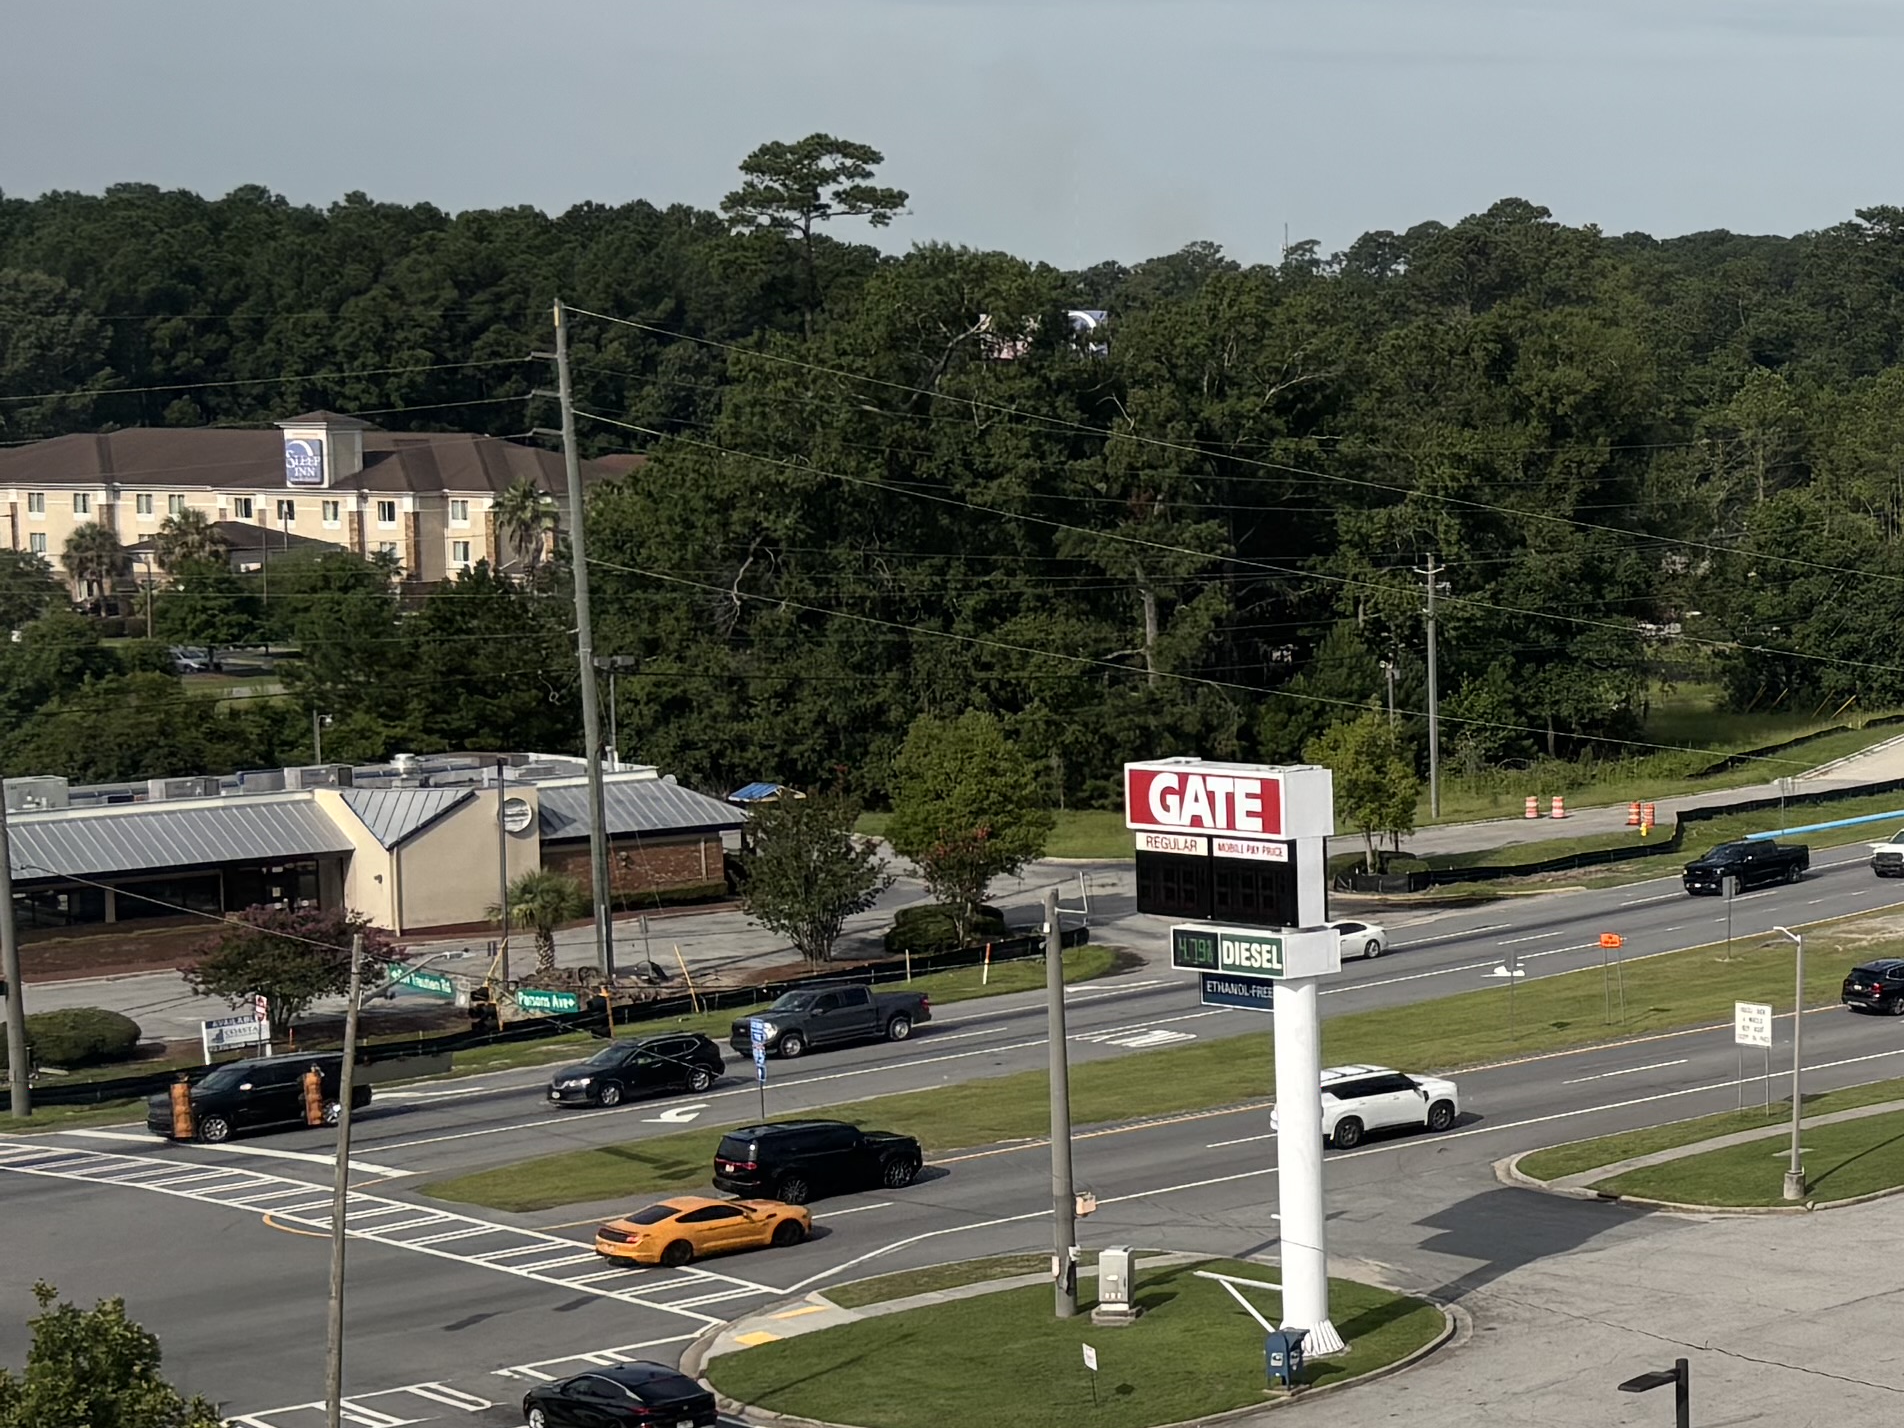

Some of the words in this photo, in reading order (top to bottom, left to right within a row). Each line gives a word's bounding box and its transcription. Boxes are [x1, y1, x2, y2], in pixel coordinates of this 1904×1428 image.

[294, 467, 315, 477] INN
[1148, 772, 1263, 832] GATE
[1146, 835, 1198, 852] REGULAR
[1222, 939, 1282, 970] DIESEL
[1206, 980, 1273, 999] ETHANOL-FREE
[518, 990, 551, 1009] Parsons
[552, 994, 568, 1009] Ave
[212, 1015, 257, 1028] AVAILABL
